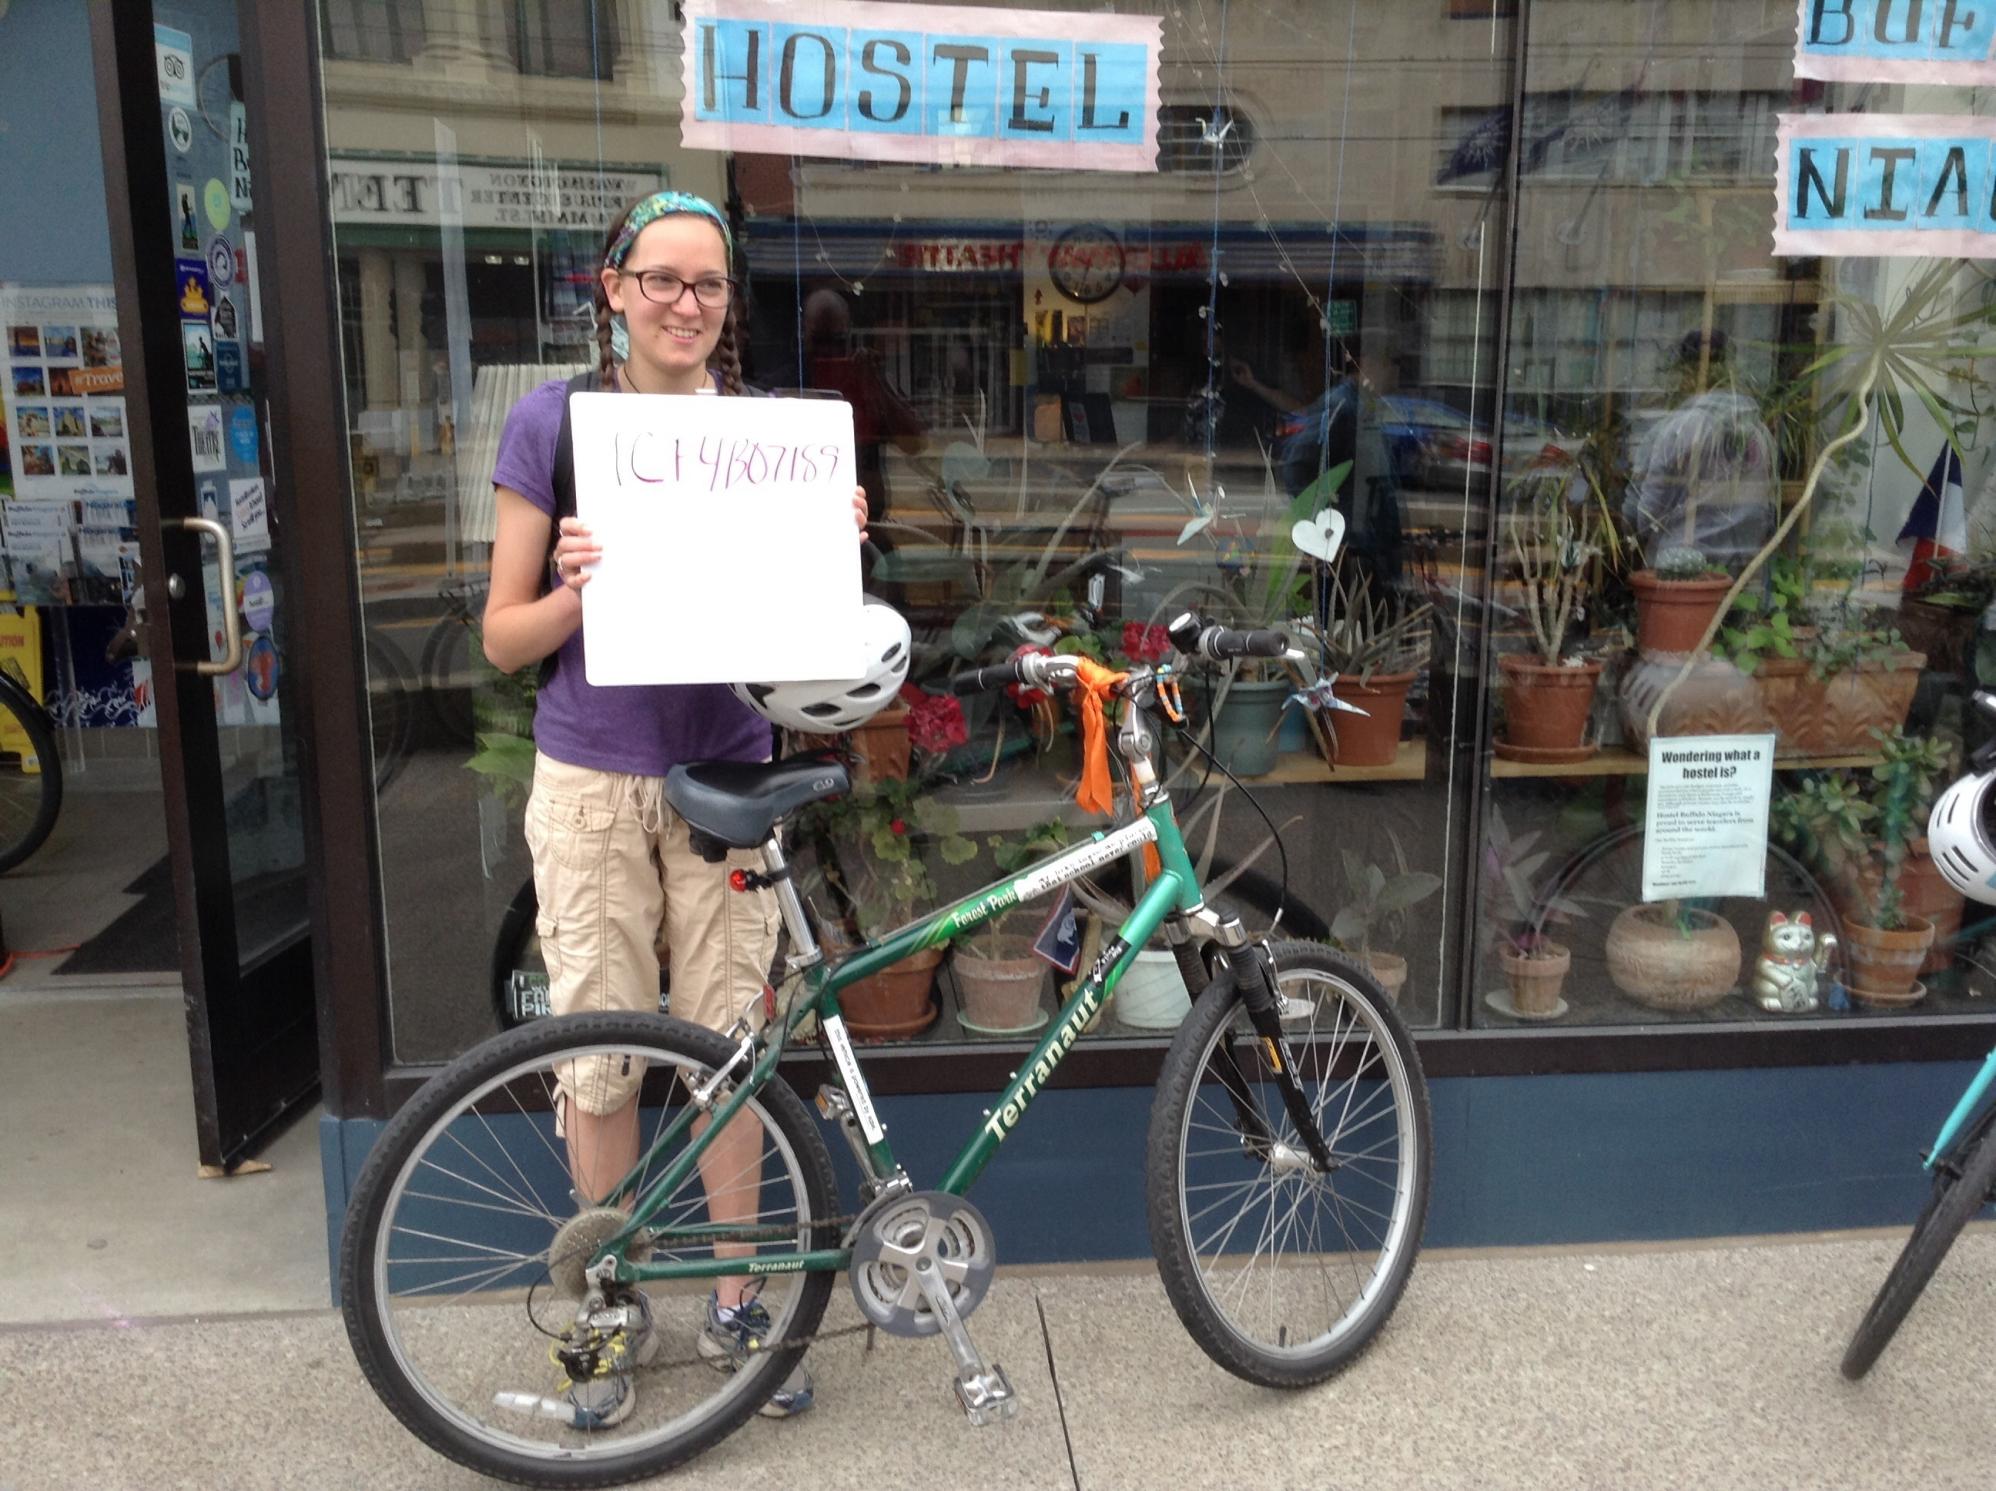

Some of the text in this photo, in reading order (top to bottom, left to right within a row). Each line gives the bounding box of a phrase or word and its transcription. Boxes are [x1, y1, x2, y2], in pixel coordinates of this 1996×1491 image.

[700, 25, 1130, 132] HOSTEL
[1794, 146, 1996, 221] NIA
[1662, 750, 1760, 764] Wondering what a
[1683, 766, 1736, 779] hostel is?
[953, 903, 989, 929] Forest
[984, 988, 1101, 1142] Terranaut
[748, 1259, 805, 1273] Terranaut
